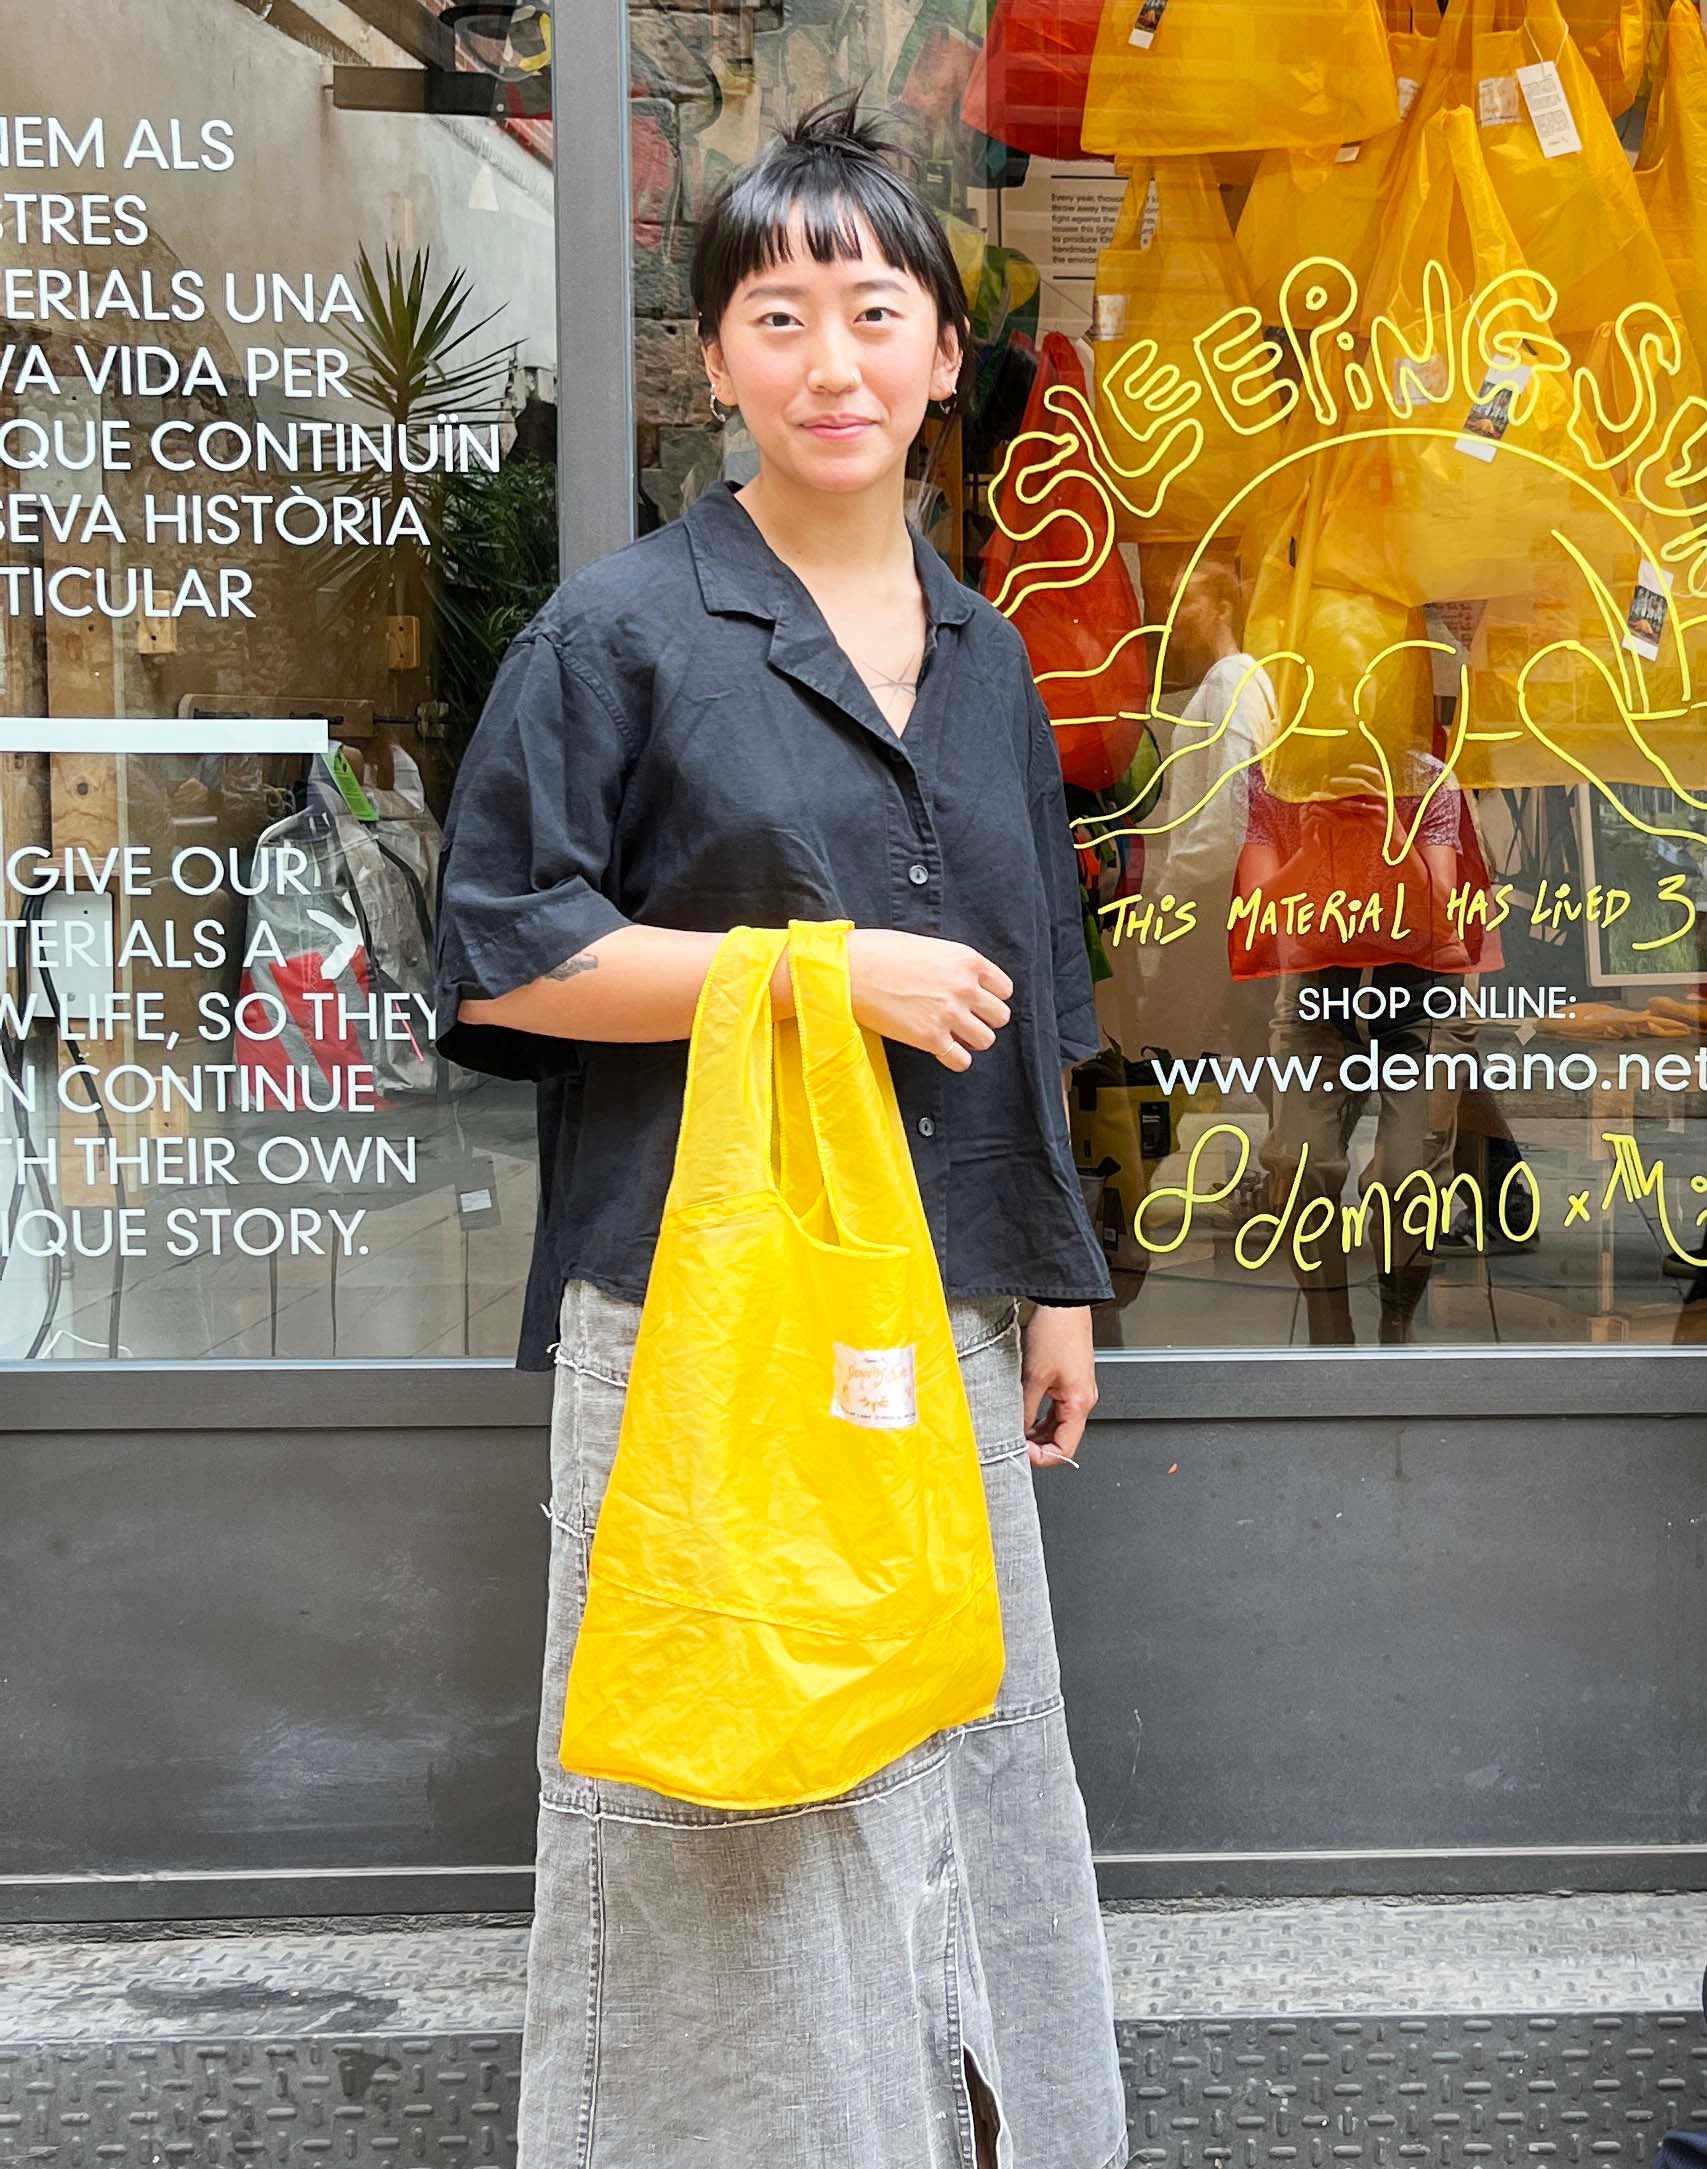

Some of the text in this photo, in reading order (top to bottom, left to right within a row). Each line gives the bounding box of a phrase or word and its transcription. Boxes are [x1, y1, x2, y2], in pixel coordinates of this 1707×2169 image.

[0, 116, 236, 171] EM ALS
[0, 193, 149, 246] TRES
[225, 272, 365, 324] UNA
[73, 345, 229, 397] VIDA
[246, 347, 353, 399] PER
[0, 413, 500, 474] QUE CONTINUÏN
[0, 485, 431, 546] EVA HISTÒRIA
[6, 846, 313, 896] GIVE OUR
[1446, 881, 1515, 941] HAS
[1632, 873, 1697, 951] 3
[242, 920, 288, 969] A
[55, 992, 181, 1051] LIFE,
[198, 991, 288, 1042] SO
[301, 992, 438, 1041] THEY
[1298, 985, 1577, 1021] SHOP ONLINE:
[57, 1063, 376, 1114] CONTINUE
[1150, 1038, 1707, 1096] www.demano.net
[73, 1136, 240, 1186] THEIR
[257, 1135, 417, 1185] OWN
[165, 1206, 370, 1258] STORY.
[1234, 1142, 1540, 1273] demano
